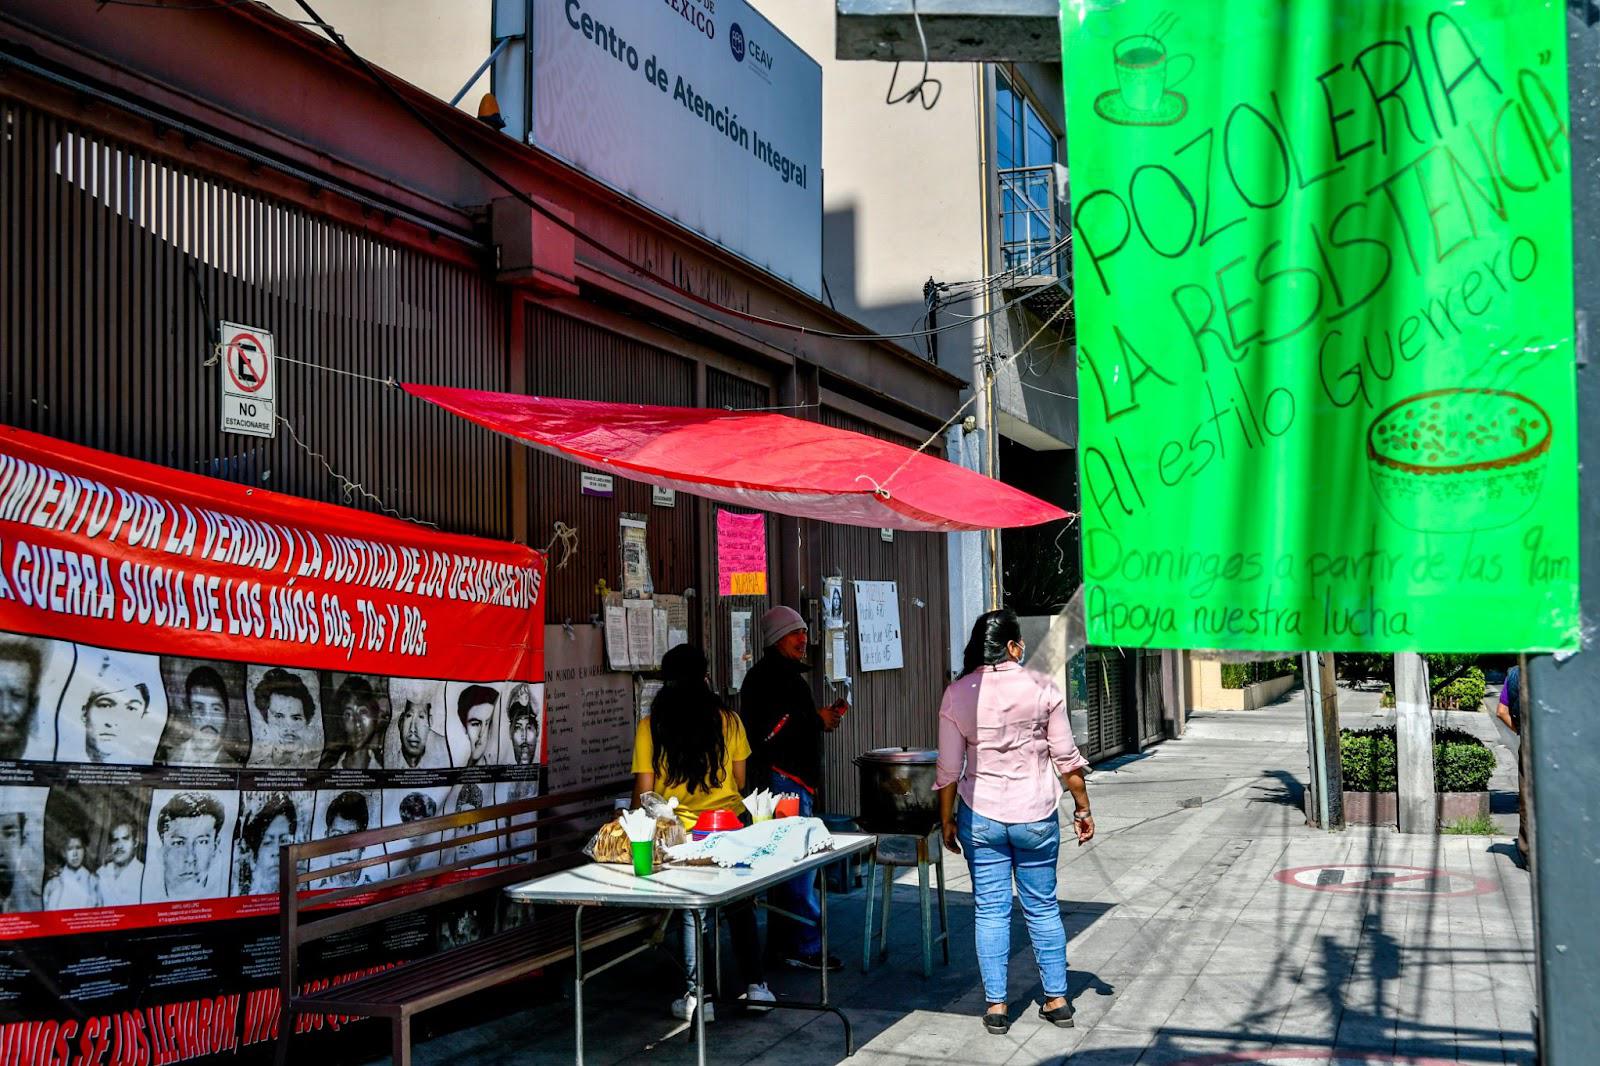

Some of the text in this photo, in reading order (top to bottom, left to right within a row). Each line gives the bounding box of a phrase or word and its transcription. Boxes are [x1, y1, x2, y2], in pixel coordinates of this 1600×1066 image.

[748, 40, 773, 70] CEAV
[564, 0, 808, 190] Centro de Atención Integral
[1073, 11, 1503, 296] POZOLERIA
[1158, 367, 1296, 486] estilo
[1319, 235, 1539, 409] Guerrero
[225, 417, 271, 431] ESTACIONARSE
[239, 402, 257, 418] NO
[0, 454, 114, 538] IMIENTO
[109, 486, 166, 550] POR
[163, 499, 198, 557] LA
[195, 506, 281, 571] VERDAD
[275, 523, 295, 574] Y
[293, 527, 323, 578] LA
[323, 533, 399, 590] JUSTICIA
[395, 545, 421, 594] DE
[416, 549, 451, 599] LOS
[1085, 527, 1264, 599] Domingos
[1274, 550, 1298, 582] a
[1306, 523, 1405, 600] partir
[1410, 528, 1448, 583] de
[1456, 528, 1503, 583] las
[11, 540, 116, 620] GUERRA
[119, 560, 190, 629] SUCIA
[192, 573, 223, 633] DE
[225, 578, 265, 639] LOS
[269, 577, 320, 645] AÑOS
[320, 592, 356, 661] 60s,
[356, 599, 387, 652] 70s
[386, 603, 401, 652] Y
[400, 603, 428, 656] 80s.
[1089, 584, 1413, 645] Apoya nuestra lucha
[72, 1015, 112, 1066] SE
[107, 1008, 150, 1066] LOS
[146, 993, 241, 1066] LLEVARON,
